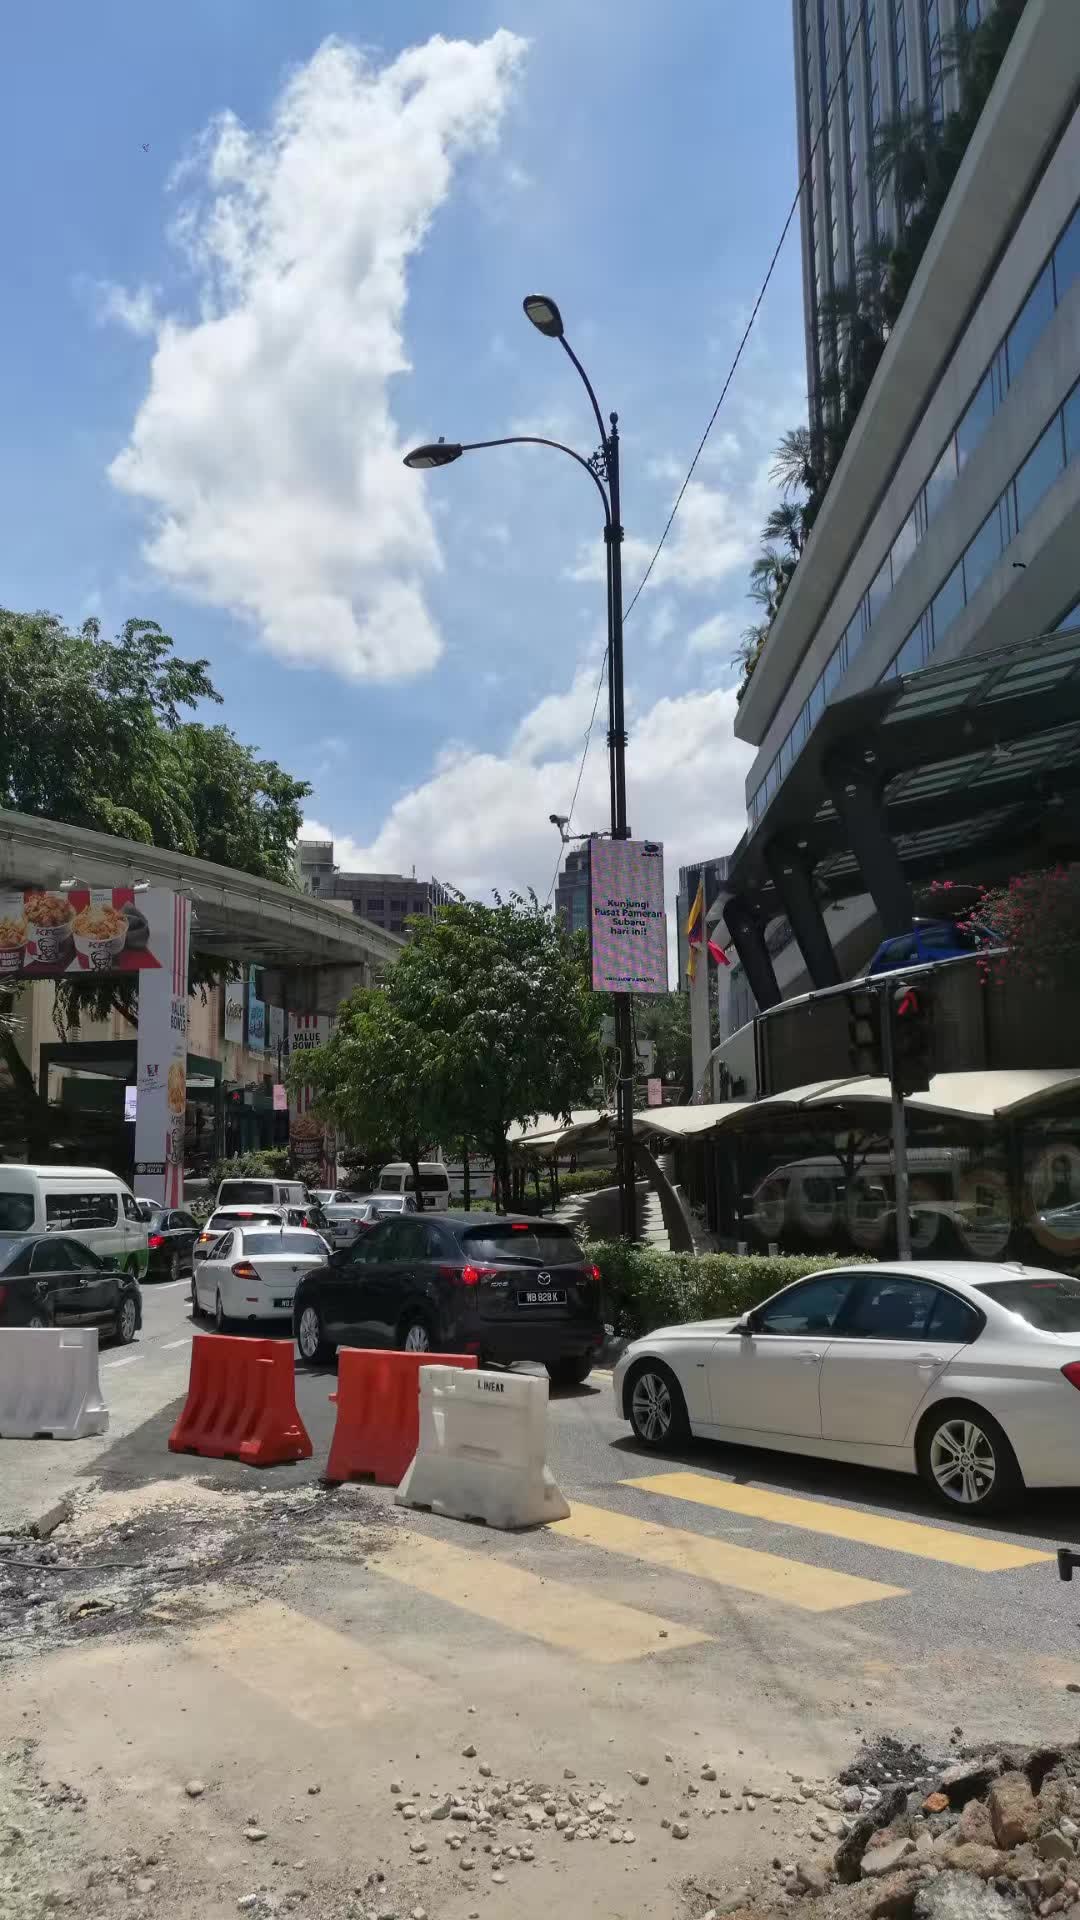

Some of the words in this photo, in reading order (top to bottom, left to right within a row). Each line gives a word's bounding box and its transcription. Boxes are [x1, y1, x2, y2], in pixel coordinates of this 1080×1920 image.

[608, 899, 649, 909] Kunjungi
[595, 908, 620, 916] Pusat
[622, 909, 662, 917] Pameran
[613, 918, 645, 926] Subaru
[88, 941, 112, 949] KFC
[294, 1033, 320, 1041] VALUE
[553, 1292, 558, 1301] K
[477, 1379, 505, 1393] LINEAR
